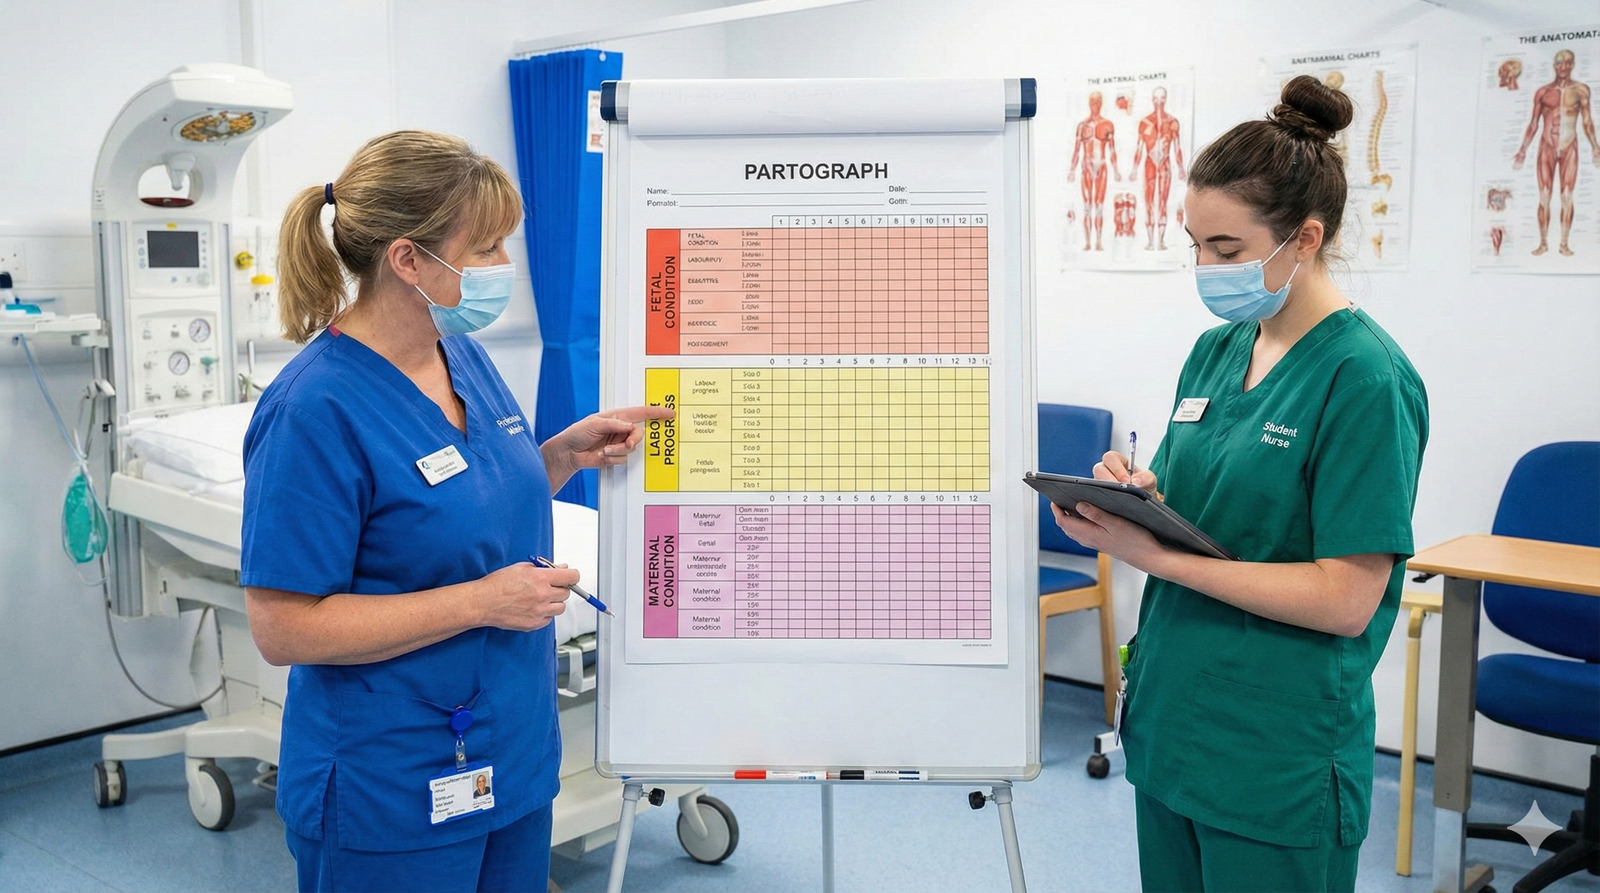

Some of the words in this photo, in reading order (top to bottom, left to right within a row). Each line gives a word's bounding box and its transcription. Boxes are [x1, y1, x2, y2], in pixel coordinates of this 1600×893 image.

[1540, 30, 1600, 42] ANATOMAT
[745, 163, 888, 180] PARTOGRAPH
[651, 272, 661, 312] FETAL
[665, 256, 675, 328] CONDITION
[650, 403, 660, 456] LABO
[664, 394, 675, 465] PROGRSS
[1261, 433, 1290, 448] Nurse
[1263, 421, 1298, 437] Student
[649, 535, 659, 606] MATERNAL
[664, 535, 674, 607] CONDITION
